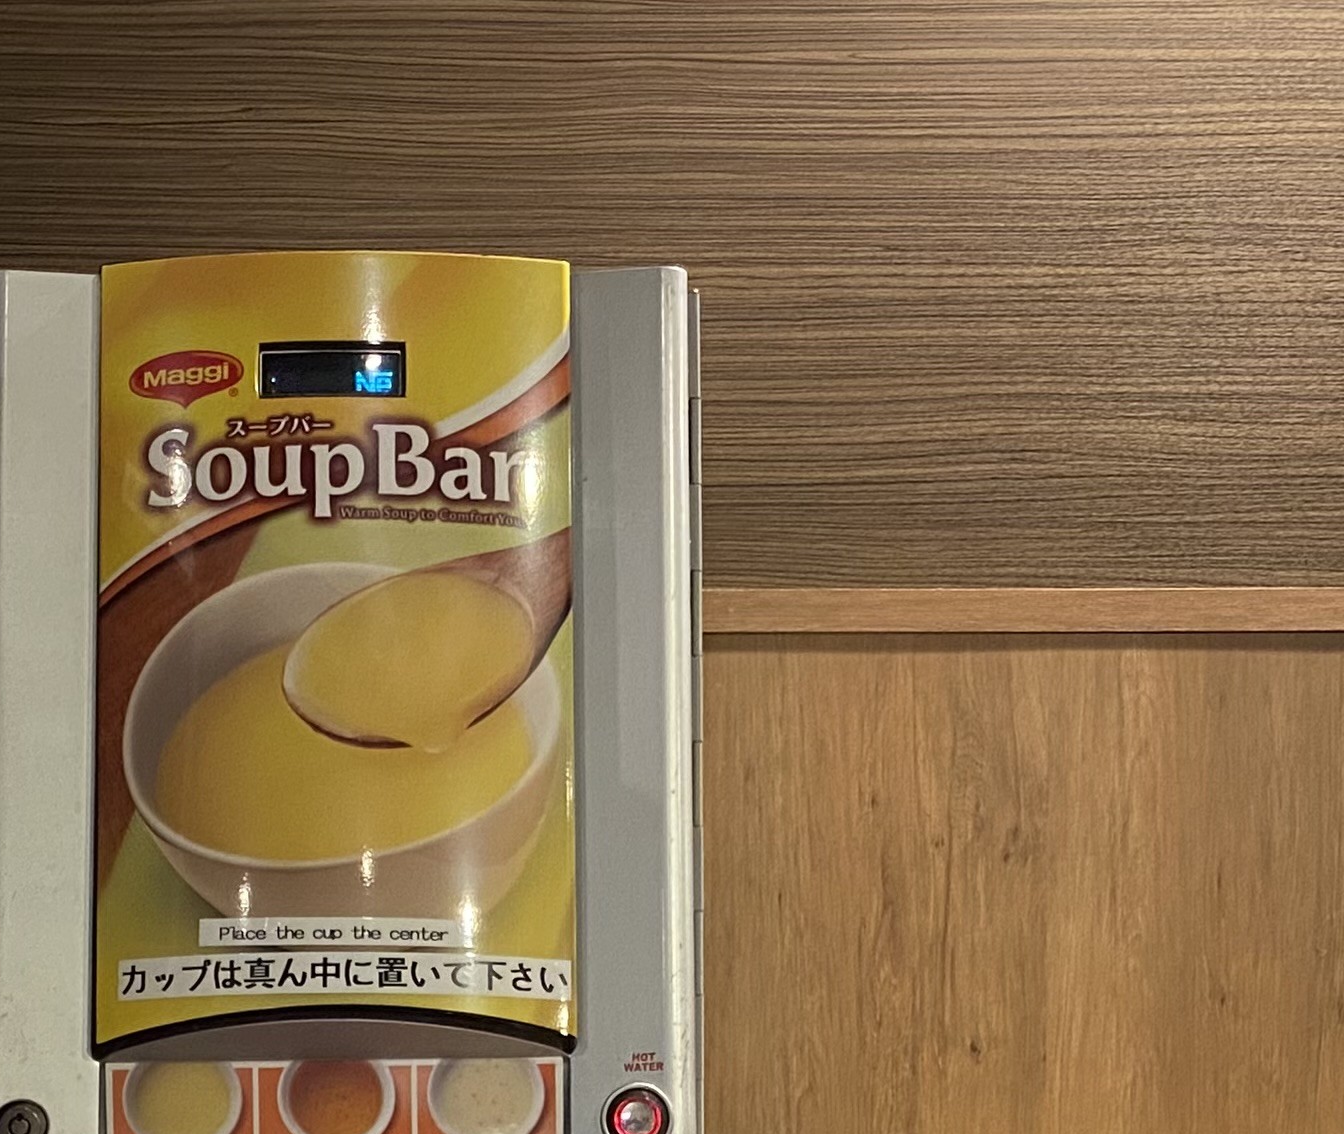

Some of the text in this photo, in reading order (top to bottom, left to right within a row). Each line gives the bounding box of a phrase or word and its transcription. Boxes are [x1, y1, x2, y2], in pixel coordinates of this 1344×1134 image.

[143, 361, 230, 389] Maggi
[228, 415, 332, 437] スープバー
[340, 506, 381, 519] Warm
[383, 507, 417, 522] Soup
[420, 508, 436, 521] to
[439, 509, 495, 524] Comfort
[219, 926, 449, 941] Place the cup the center
[121, 956, 568, 996] カップは真ん中に置いて下さい
[631, 1052, 656, 1062] HOT
[623, 1062, 665, 1072] WATER
